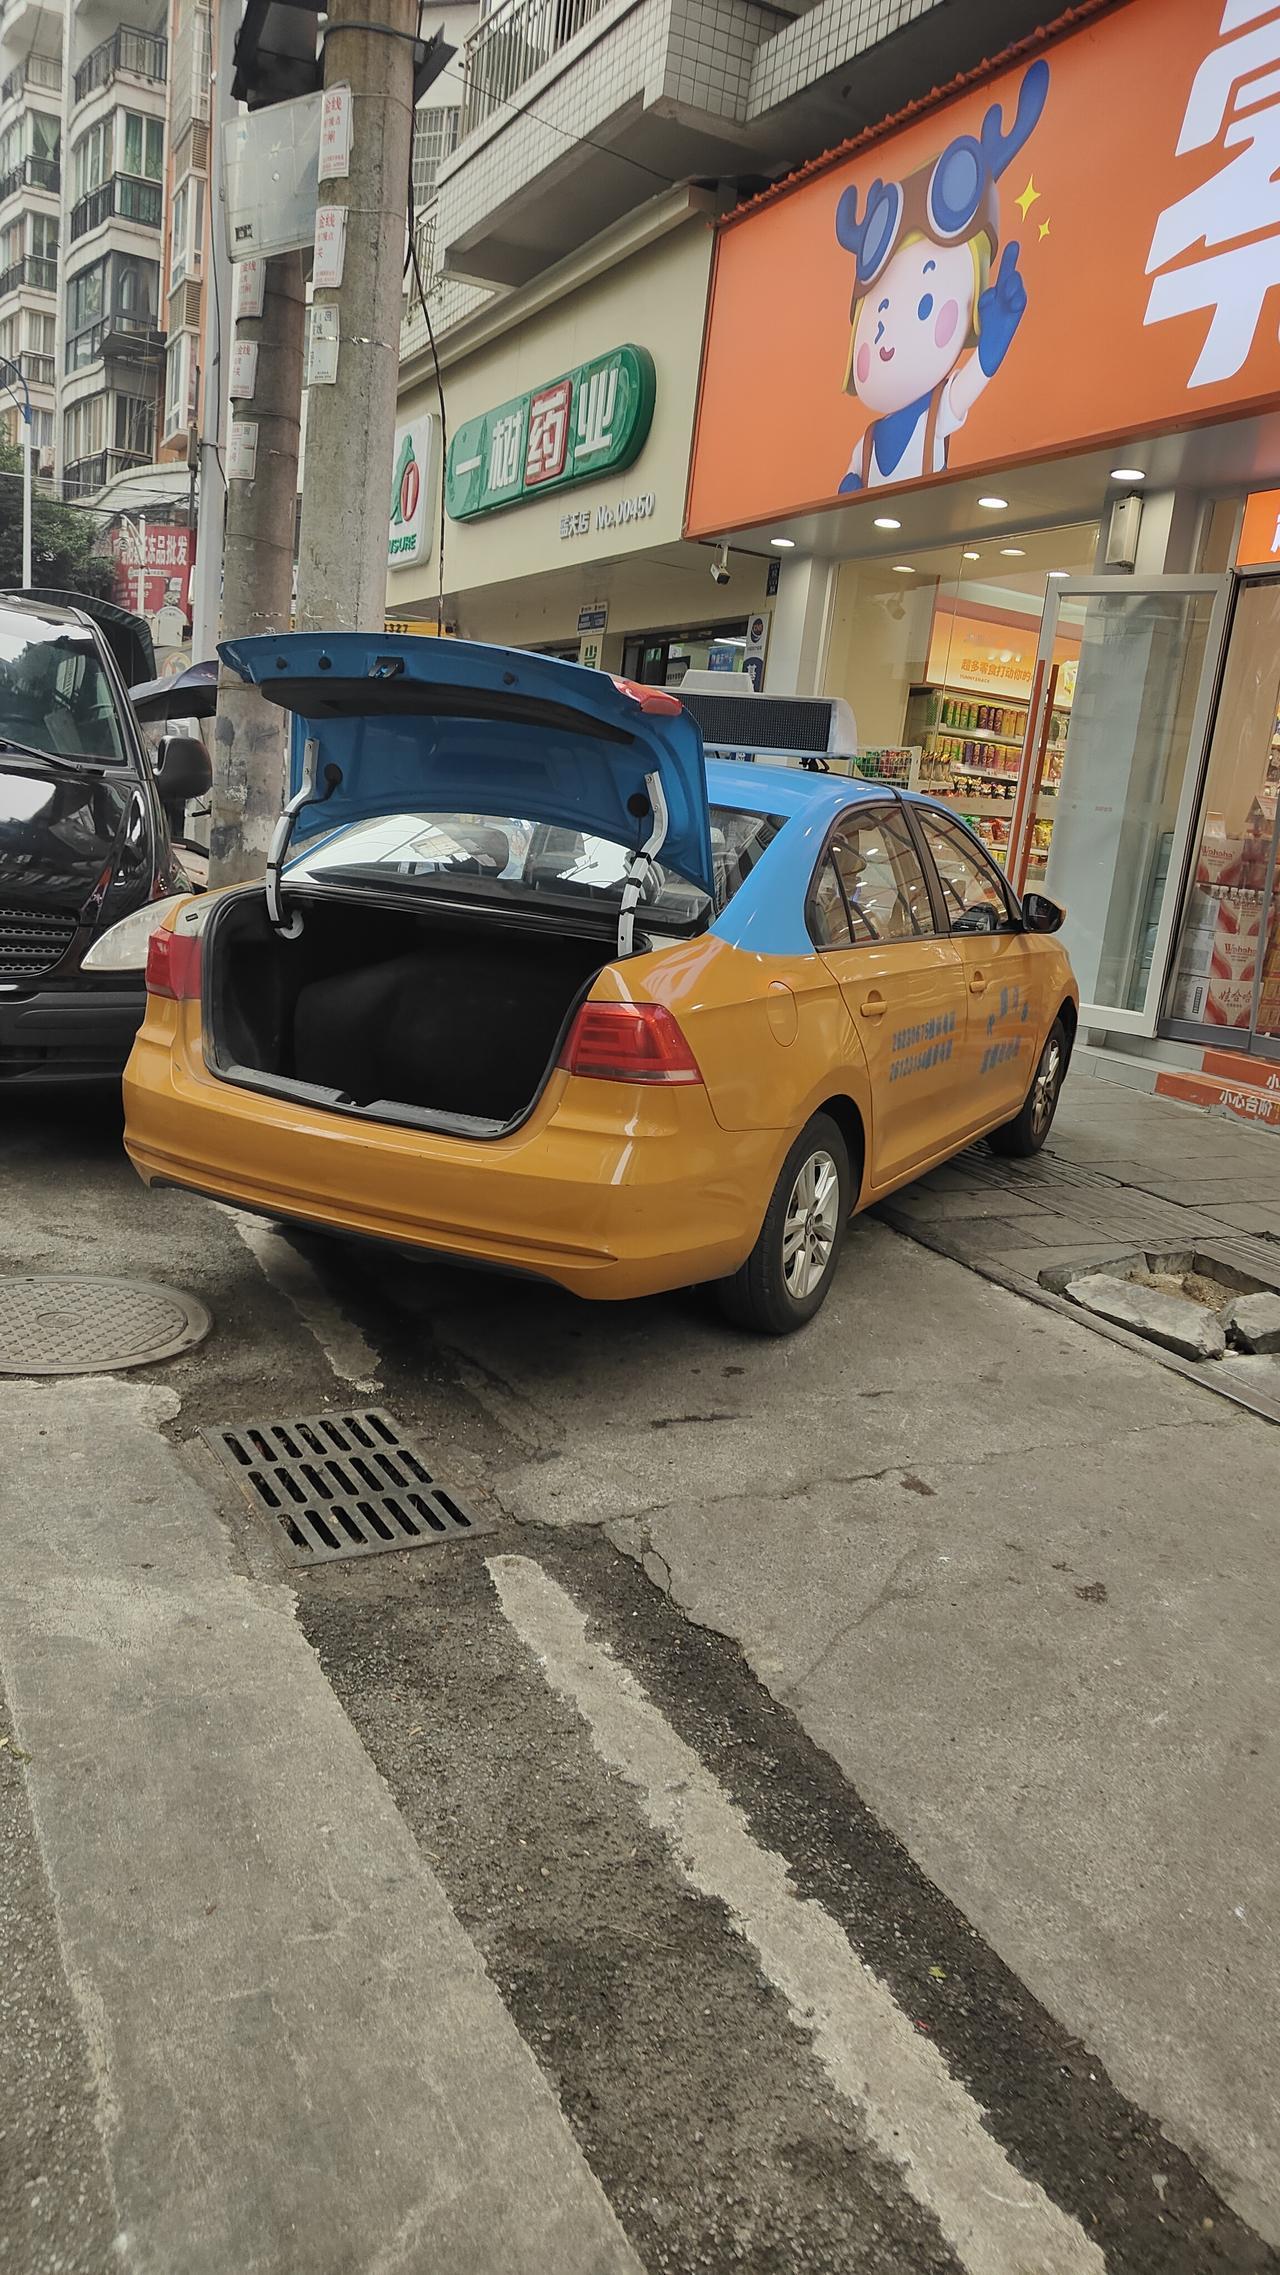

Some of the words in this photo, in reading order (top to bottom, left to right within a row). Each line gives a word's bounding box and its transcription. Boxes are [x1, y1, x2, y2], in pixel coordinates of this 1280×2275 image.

[456, 367, 619, 491] 一树药业
[560, 510, 590, 539] 蓝天店
[596, 494, 655, 531] No.00450
[961, 658, 1033, 683] 超多零食打动你的
[1219, 1090, 1273, 1117] 小心台阶
